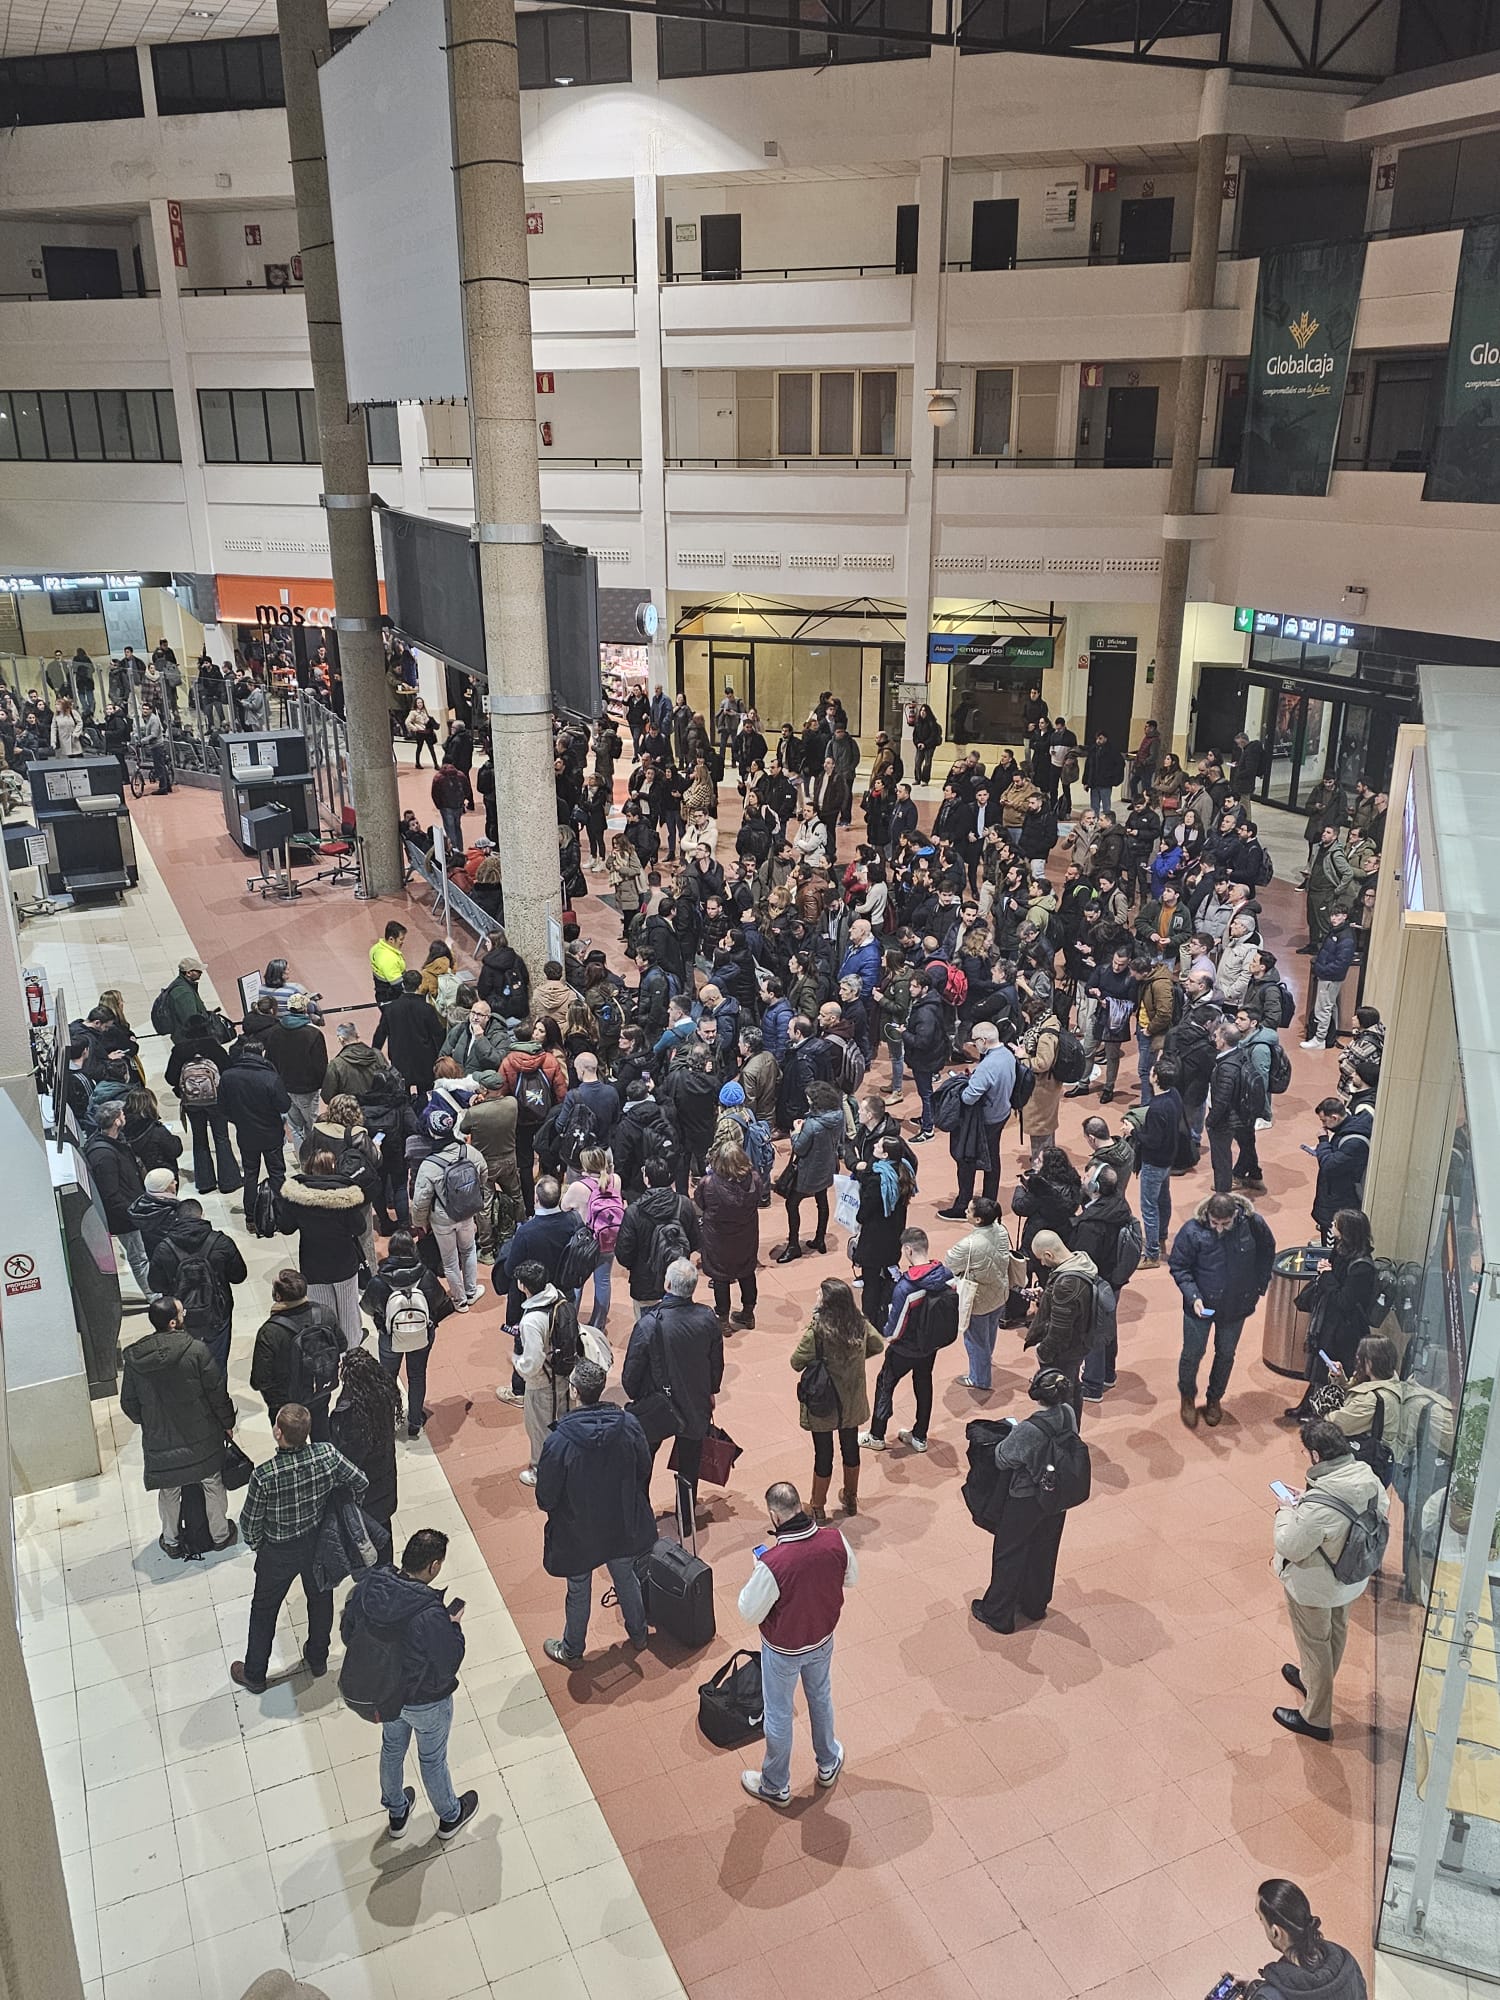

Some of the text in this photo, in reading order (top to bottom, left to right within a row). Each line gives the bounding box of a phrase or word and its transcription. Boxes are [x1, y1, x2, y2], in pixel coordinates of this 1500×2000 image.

[1470, 341, 1500, 365] Glo
[1266, 353, 1334, 379] Globalcaja
[1257, 613, 1279, 625] Salida
[1301, 619, 1317, 631] Taxi
[1340, 625, 1355, 637] Bus
[934, 645, 954, 653] Alamo
[957, 645, 1003, 655] enterprise
[1016, 648, 1045, 657] National
[7, 1279, 38, 1288] PROHIBIDO
[20, 1283, 37, 1291] PASO
